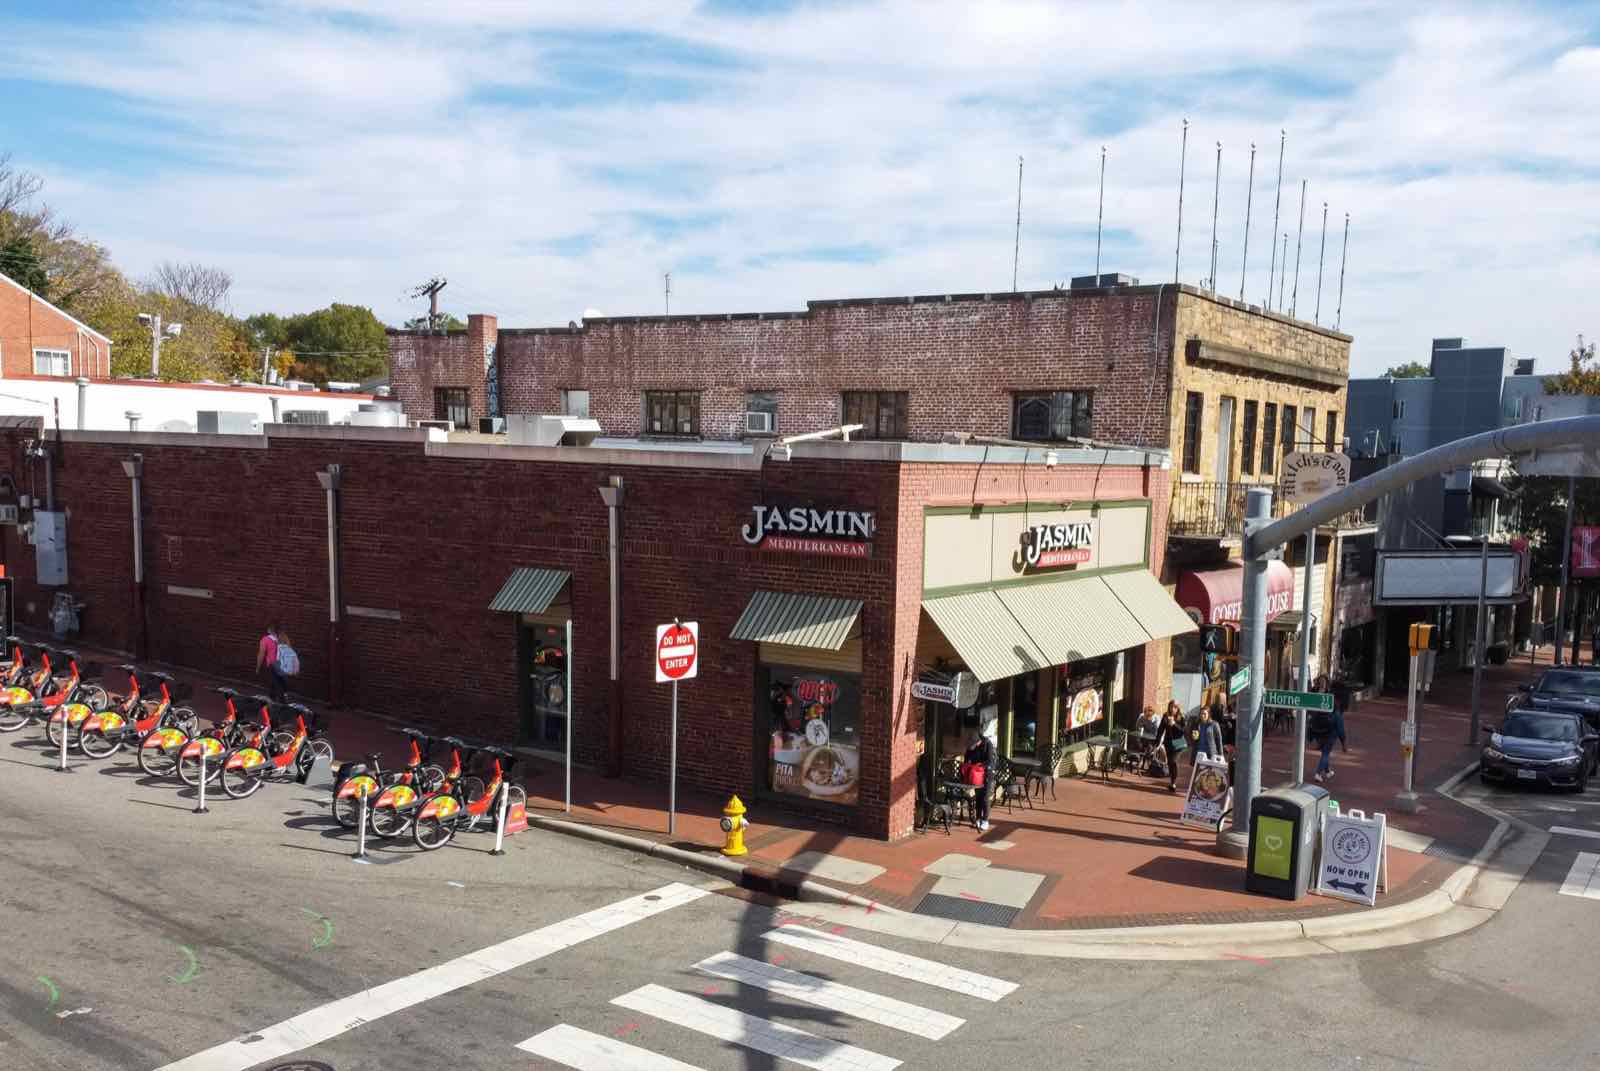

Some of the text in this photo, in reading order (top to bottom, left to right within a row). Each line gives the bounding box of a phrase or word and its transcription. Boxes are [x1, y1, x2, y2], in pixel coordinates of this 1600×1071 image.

[741, 505, 871, 543] JASMIN
[767, 538, 866, 555] MEDITERRANEAN
[1027, 523, 1093, 563] JASMIN
[1264, 591, 1290, 615] OUSE
[663, 633, 690, 646] DO NOT
[665, 658, 689, 669] ENTER
[920, 685, 953, 697] JASMIN
[1269, 691, 1301, 705] Horne
[1326, 864, 1370, 880] NOW OPEN
